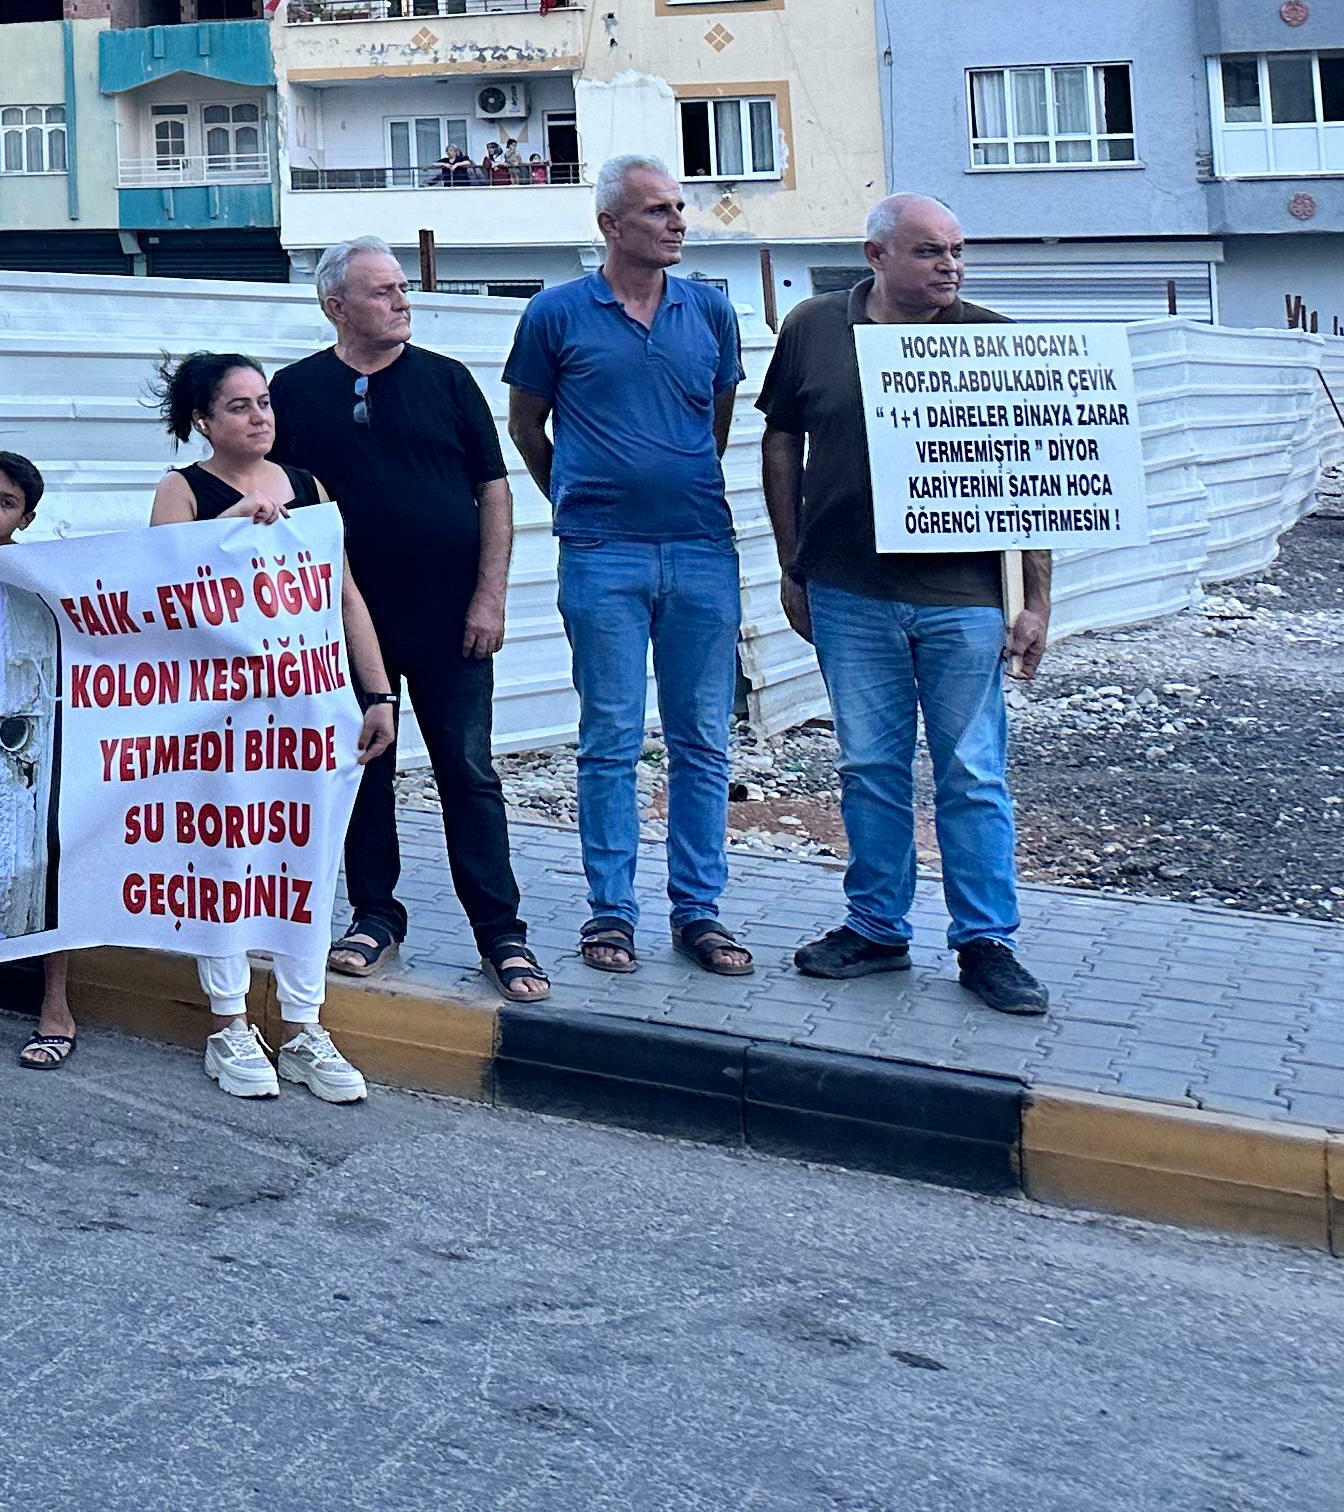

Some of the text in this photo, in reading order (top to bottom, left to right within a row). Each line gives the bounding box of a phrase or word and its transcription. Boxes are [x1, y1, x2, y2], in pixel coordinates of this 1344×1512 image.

[900, 334, 1088, 358] HOCAYA BAK HOCAYA !
[1067, 362, 1117, 397] ÇEVİK
[890, 406, 921, 428] 1+1
[926, 399, 1009, 428] DAİRELER
[1013, 398, 1073, 427] BİNAYA
[1076, 403, 1130, 426] ZARAR
[915, 433, 1031, 468] VERMEMİŞTİR
[1048, 433, 1099, 462] DİYOR
[908, 469, 1113, 499] KARİYERİNİ SATAN HOCA
[905, 503, 1121, 538] ÖĞRENCİ YETİŞTİRMESİN !
[60, 578, 142, 637] FAİK
[156, 565, 248, 631] EYÜP
[251, 550, 332, 619] ÖĞÜT
[70, 629, 346, 709] KOLON KESTİĞİNİZ
[99, 714, 337, 782] YETMEDİ BİRDE
[124, 799, 311, 850] SU BORUSU
[122, 861, 313, 931] GEÇİRDİNİZ
